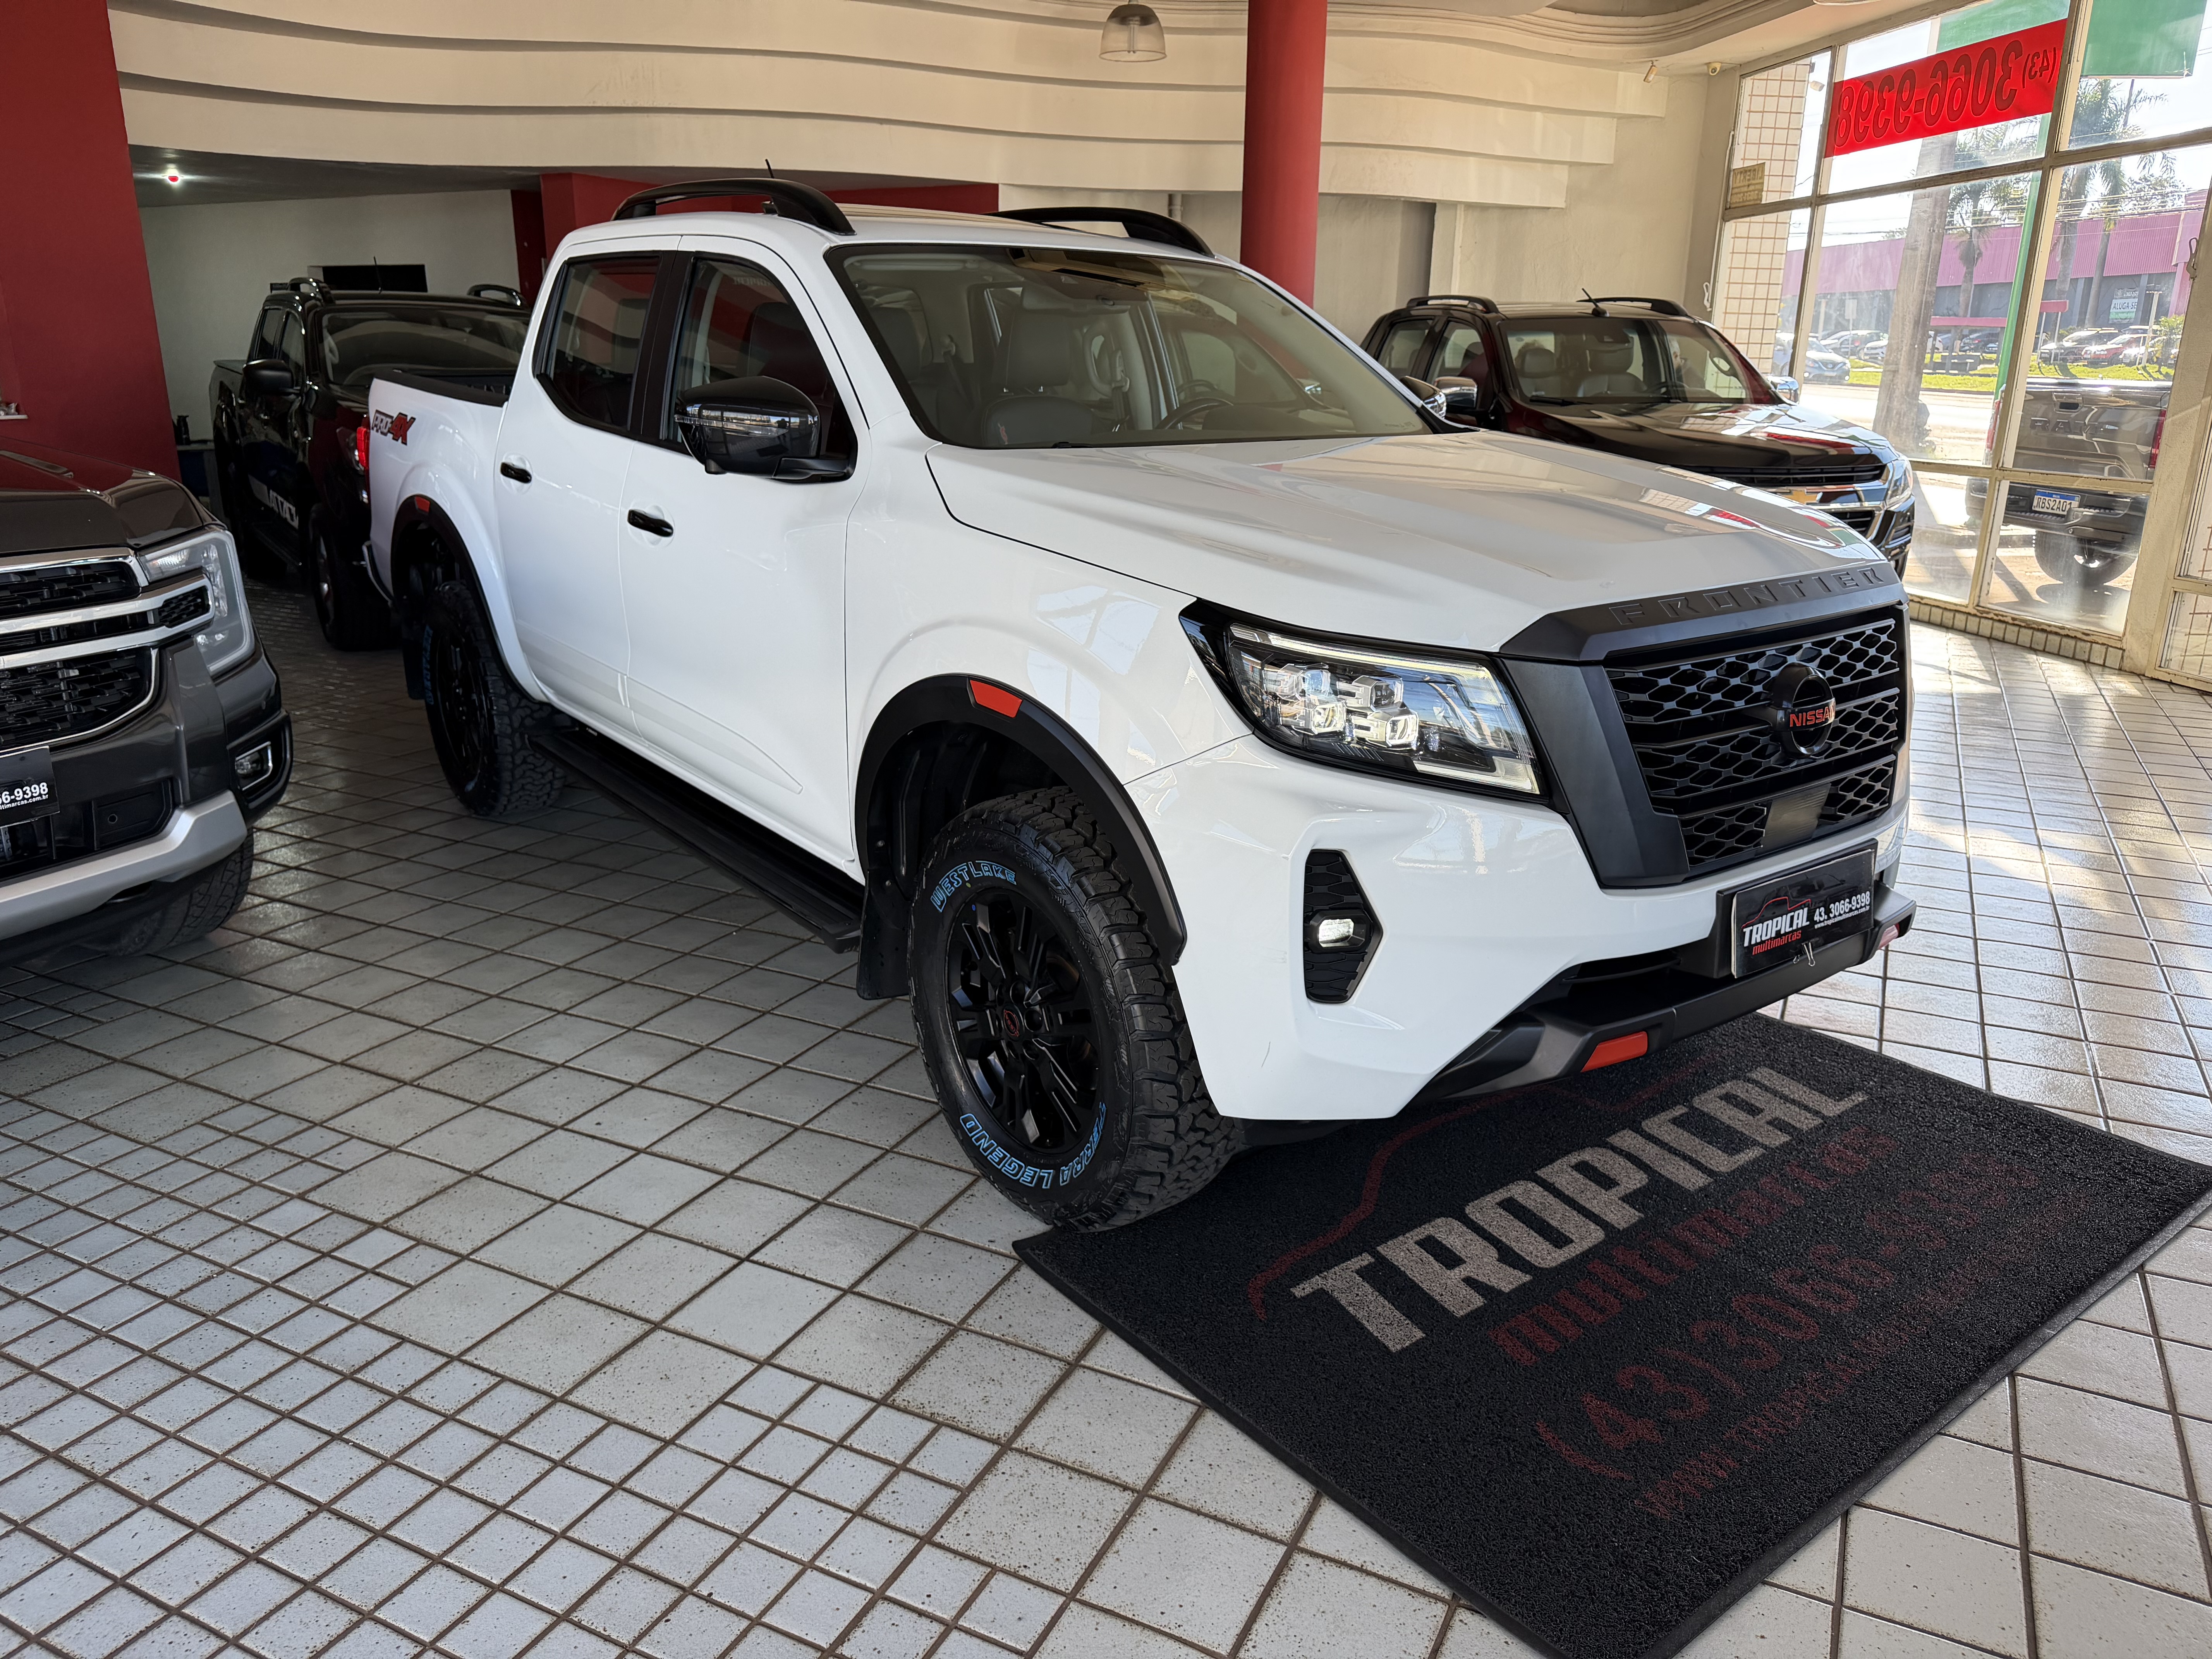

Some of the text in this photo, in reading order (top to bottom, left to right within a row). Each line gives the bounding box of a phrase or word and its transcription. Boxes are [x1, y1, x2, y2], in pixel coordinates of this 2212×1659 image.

[2112, 302, 2137, 310] ALUGA-SE
[2030, 417, 2098, 434] RAM
[1608, 567, 1884, 625] FRONTIER
[0, 782, 48, 805] 6-9398
[930, 860, 1017, 912] WESTLAKE
[1829, 891, 1870, 918] 3066-9398
[1743, 907, 1810, 947] TROPICAL
[1752, 930, 1802, 955] multimarcas
[960, 1102, 1106, 1189] TERRA LEGEND
[1290, 1066, 1868, 1353] TROPICAL
[1487, 1125, 1898, 1367] multimarcas
